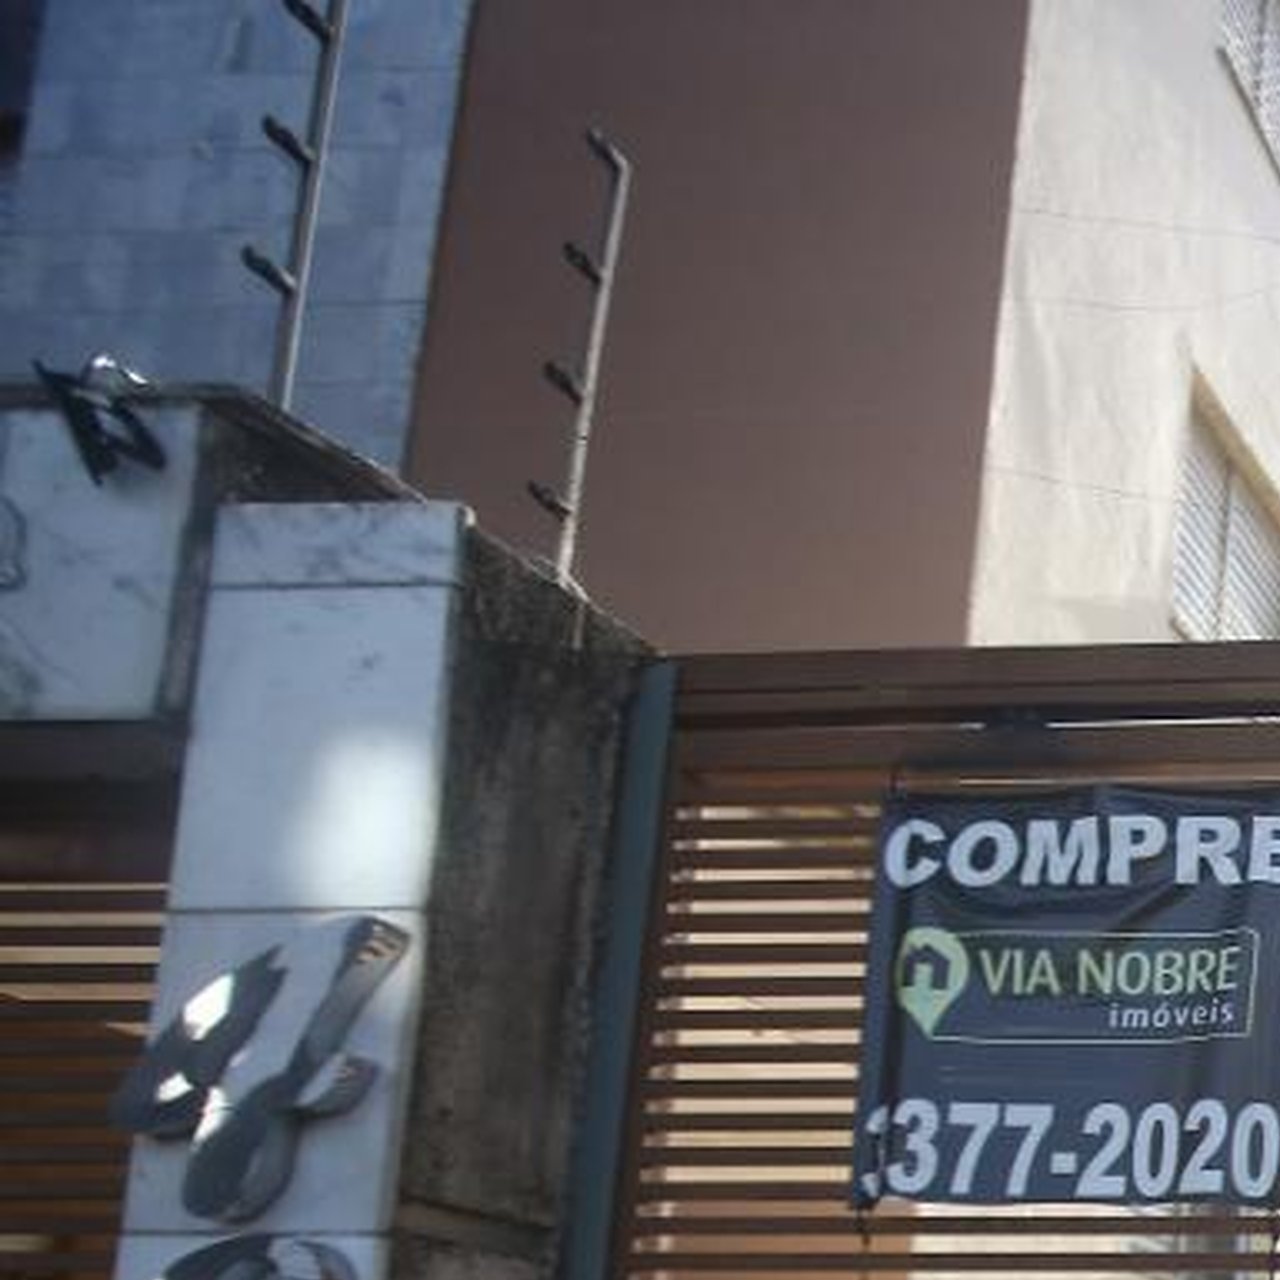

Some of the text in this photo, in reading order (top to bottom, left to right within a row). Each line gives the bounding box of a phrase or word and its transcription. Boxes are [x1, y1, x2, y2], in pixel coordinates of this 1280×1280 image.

[979, 945, 1242, 997] VIA NOBRE
[1108, 999, 1235, 1030] imóveis
